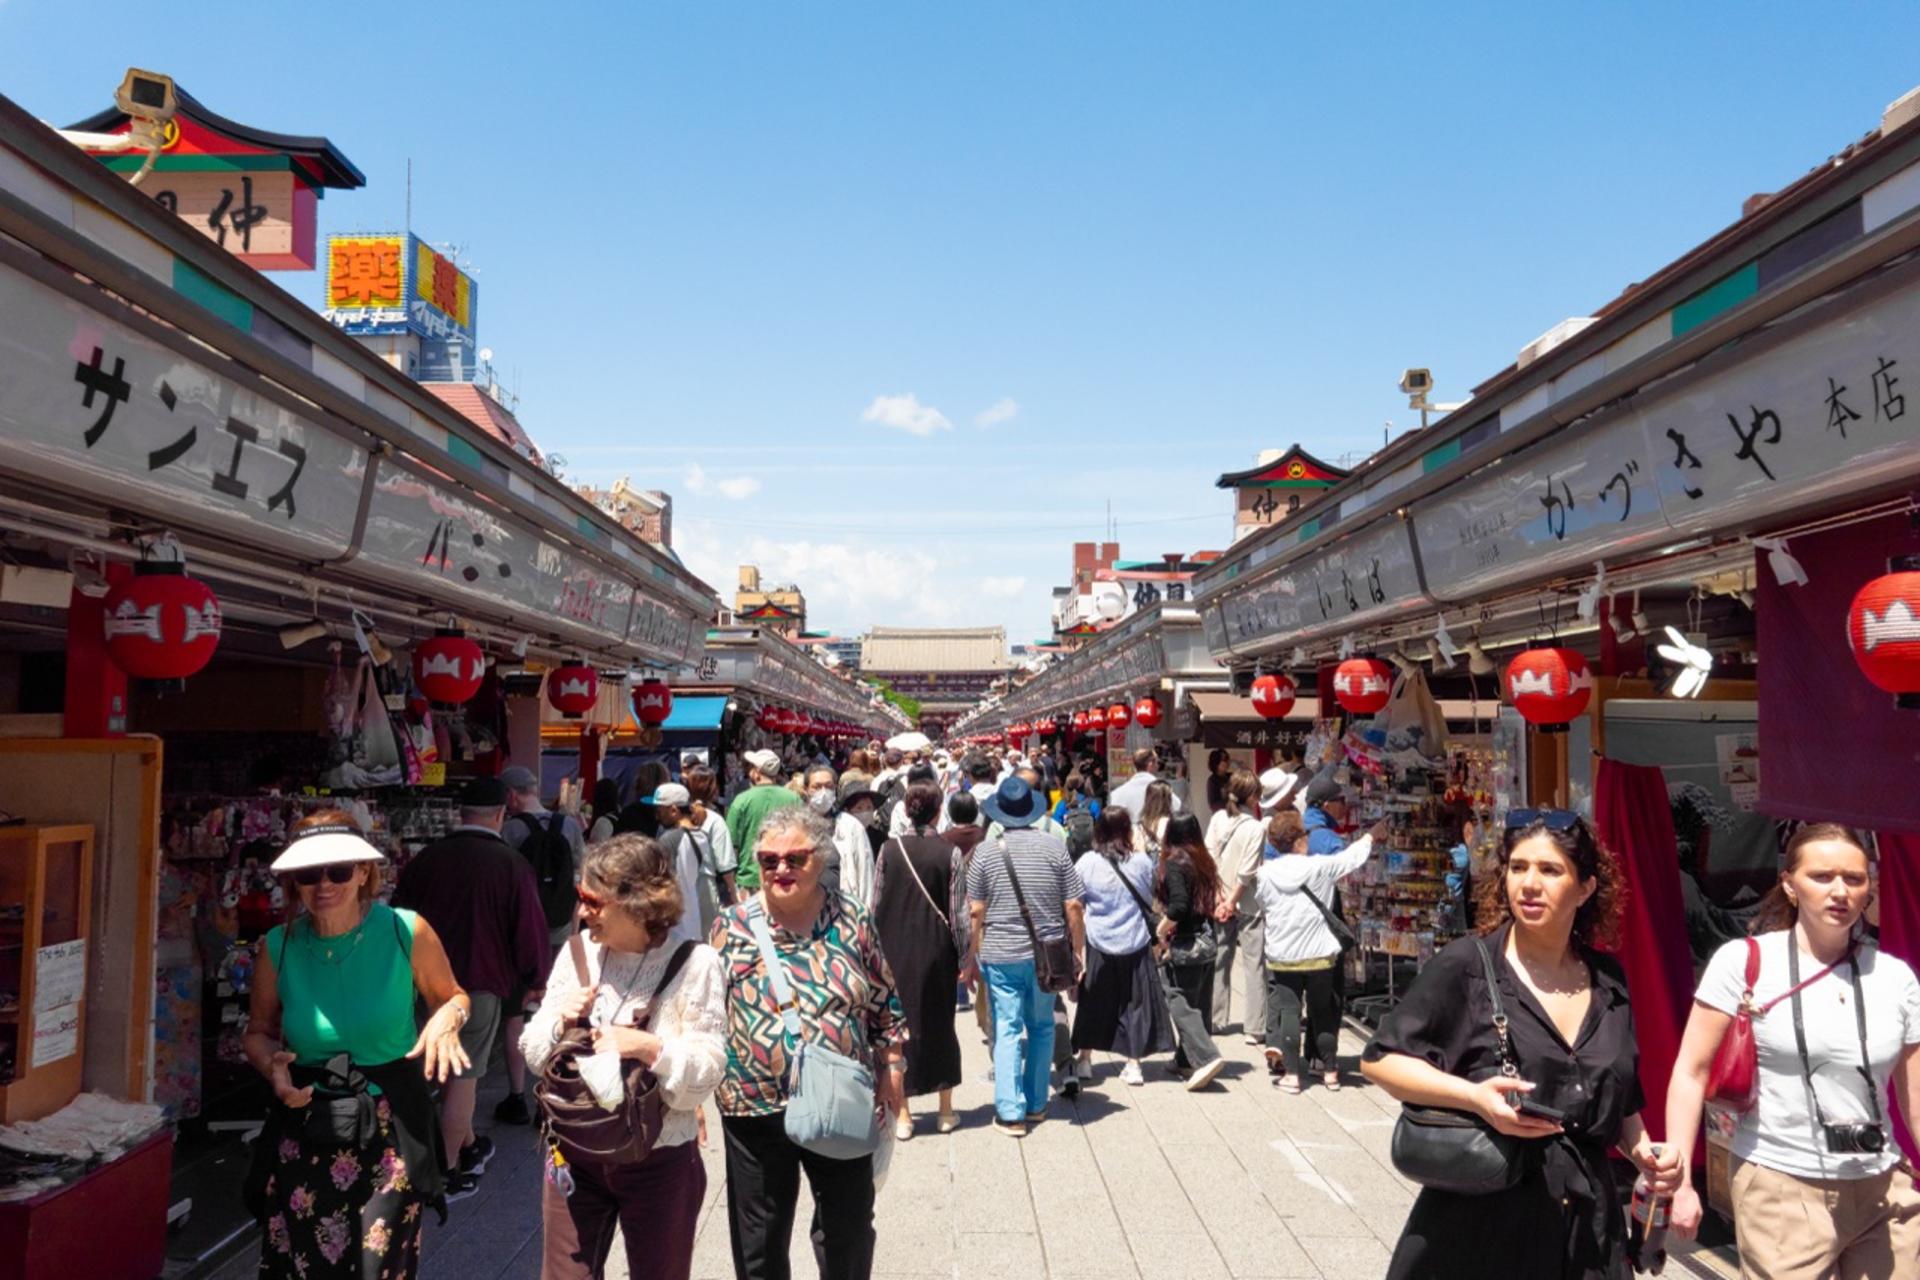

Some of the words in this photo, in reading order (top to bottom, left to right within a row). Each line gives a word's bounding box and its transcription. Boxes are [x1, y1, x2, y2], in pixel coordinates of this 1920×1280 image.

[74, 345, 306, 520] サンエス
[1539, 404, 1782, 541] かづさや
[1824, 356, 1906, 440] 本店
